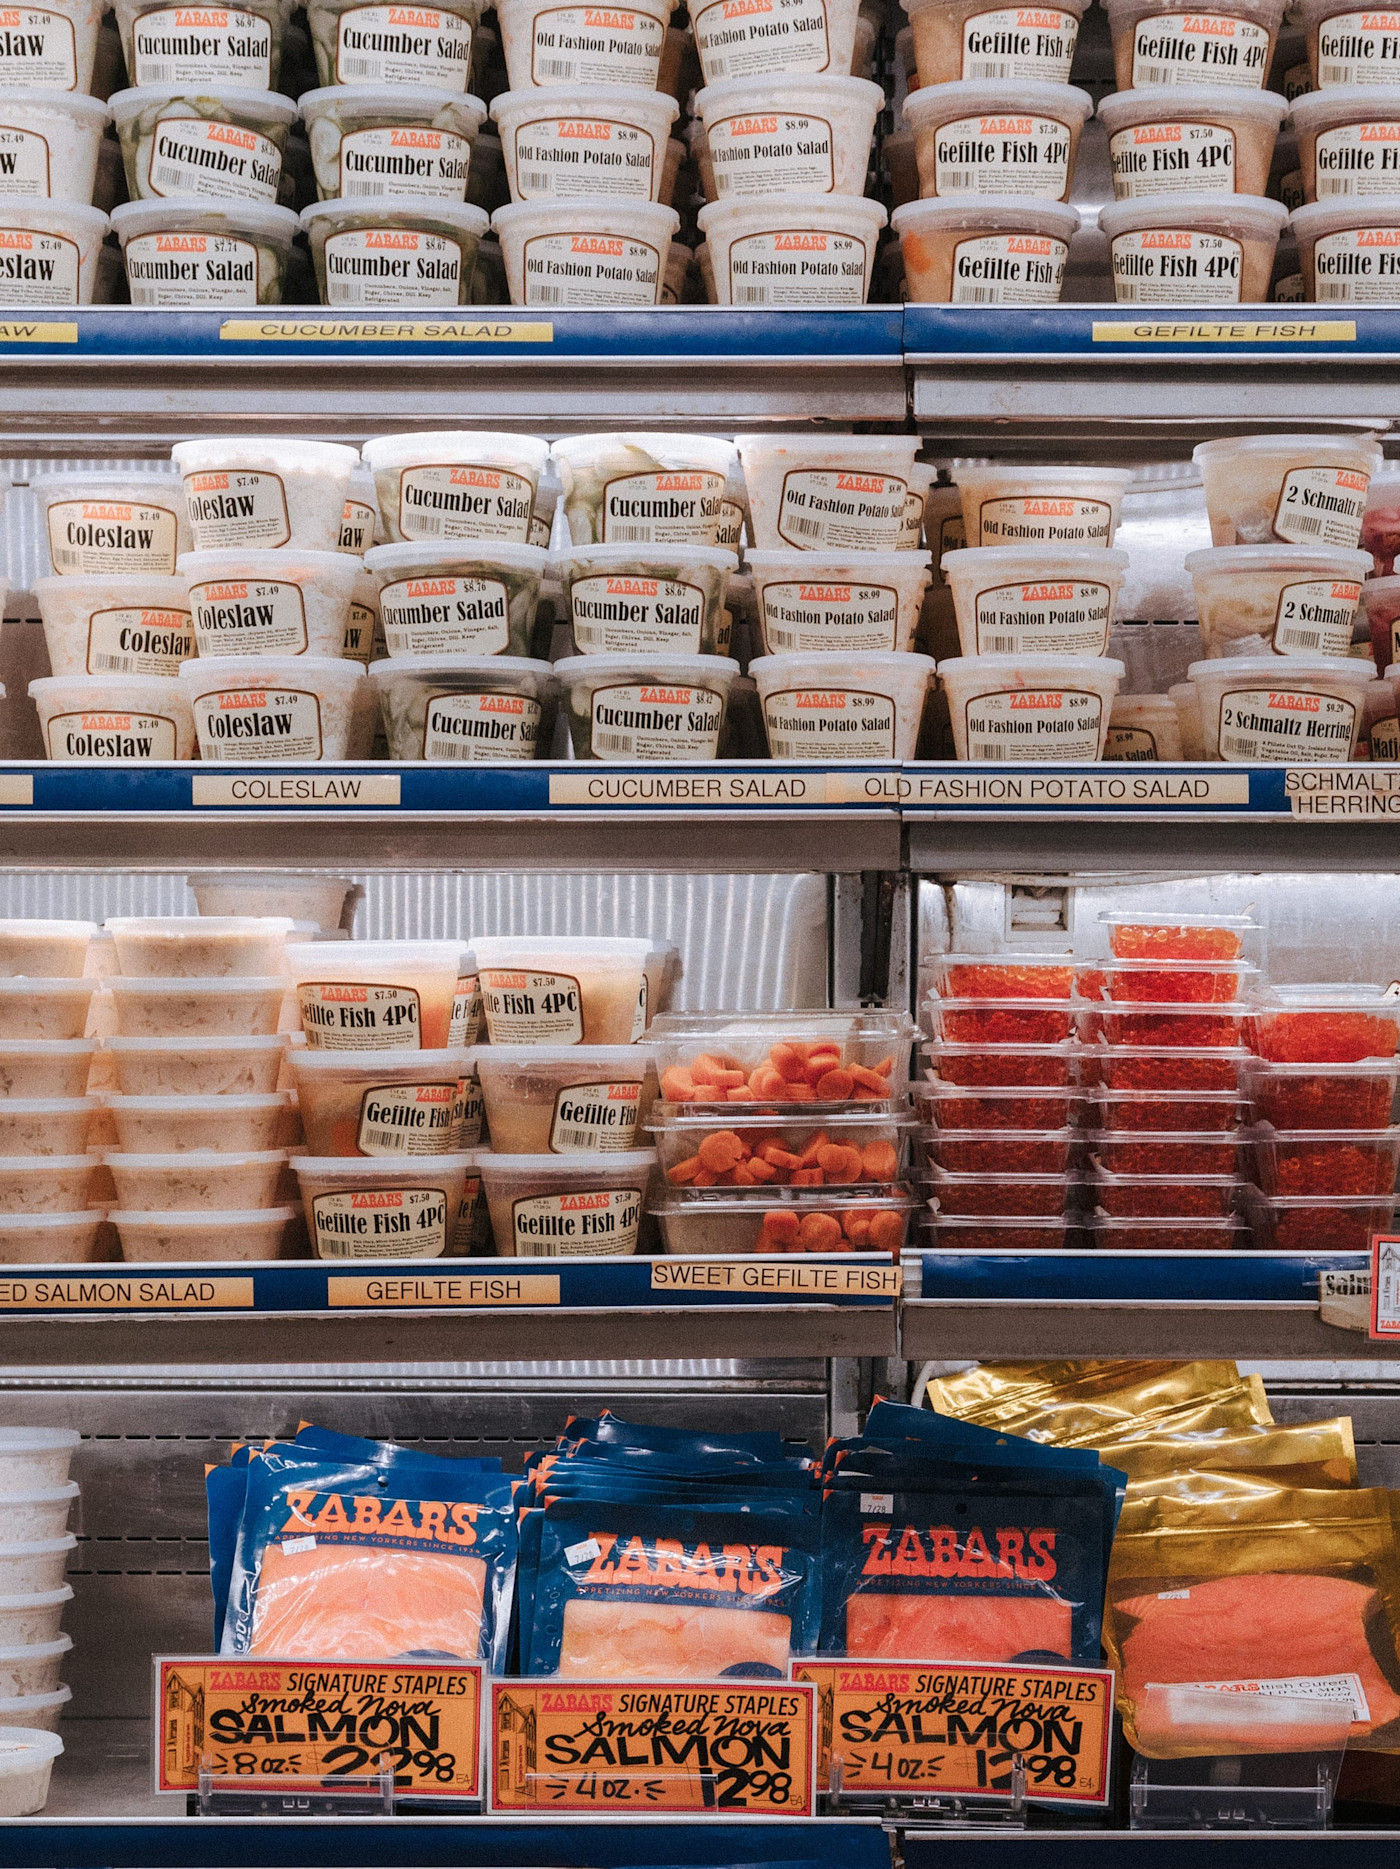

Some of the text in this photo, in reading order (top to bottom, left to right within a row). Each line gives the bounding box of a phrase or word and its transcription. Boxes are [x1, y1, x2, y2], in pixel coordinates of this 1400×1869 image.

[138, 34, 268, 58] Cucumber Salad
[1138, 34, 1266, 67] Gefilte Fish 4PC
[618, 130, 638, 141] $8.99
[1039, 124, 1058, 134] $7.50
[518, 145, 650, 167] Old Fashion Potato Salad
[938, 140, 1069, 164] Gefilte Fish 4PC
[214, 241, 237, 252] $7.74
[833, 240, 853, 250] $8.99
[1200, 238, 1223, 248] $7.50
[129, 256, 254, 281] Cucumber Salad
[328, 252, 458, 280] Cucumber Salad
[733, 259, 863, 276] Old Fashion Potato Salad
[1112, 252, 1239, 278] Gefilte Fish 4PC
[261, 323, 512, 337] CUCUMBER SALAD
[1134, 325, 1316, 338] GEFILTE FISH
[139, 512, 160, 521] $7.49
[67, 522, 154, 549] Coleslaw
[463, 581, 487, 592] $8.76
[664, 586, 686, 597] $8.67
[858, 589, 880, 600] $8.99
[384, 598, 504, 625] Cucumber Salad
[574, 596, 699, 624] Cucumber Salad
[766, 603, 894, 624] Old Fashion Potato Salad
[274, 695, 298, 706] $7.49
[1326, 704, 1344, 712] $9.29
[138, 720, 159, 729] $7.49
[208, 712, 292, 738] Coleslaw
[1224, 709, 1350, 742] 2 Schmaltz Herring
[66, 733, 152, 757] Coleslaw
[231, 781, 361, 798] COLESLAW
[588, 779, 806, 798] CUCUMBER SALAD
[864, 779, 1209, 798] OLD FASHION POTATO SALAD
[1286, 772, 1400, 791] SCHMALT
[1298, 795, 1400, 814] HERRING
[374, 990, 398, 1000] $7.50
[340, 1002, 416, 1027] Fish 4PC
[409, 1193, 430, 1203] $7.50
[317, 1204, 444, 1234] Gefilte Fish 4PC
[517, 1212, 615, 1235] Gefilte Fish
[654, 1264, 897, 1289] SWEET GEFILTE FISH
[35, 1283, 132, 1301] SALMON
[139, 1283, 215, 1301] SALAD
[366, 1280, 520, 1300] GEFILTE FISH
[280, 1490, 481, 1546] ZABAR'S
[371, 1537, 418, 1546] YORKERS
[422, 1542, 453, 1550] SINCE
[576, 1586, 640, 1596] APPETIZING
[646, 1589, 669, 1597] NEW
[673, 1591, 721, 1600] YORKERS
[926, 1580, 948, 1588] NEW
[954, 1581, 1000, 1589] YORKERS
[287, 1674, 387, 1693] SIGNATURE
[392, 1674, 467, 1695] STAPLES
[916, 1674, 1014, 1696] SIGNATURE
[1021, 1677, 1096, 1700] STAPLES
[236, 1690, 352, 1715] Smoked
[619, 1694, 718, 1713] SIGNATURE
[726, 1697, 798, 1716] STAPLES
[873, 1694, 986, 1717] Smoked
[209, 1710, 440, 1750] SALMON
[574, 1712, 713, 1737] Smoked
[839, 1710, 1081, 1754] SALMON
[545, 1734, 790, 1769] SALMON
[236, 1753, 257, 1774] 8
[872, 1752, 893, 1780] 4
[576, 1772, 597, 1798] 4
